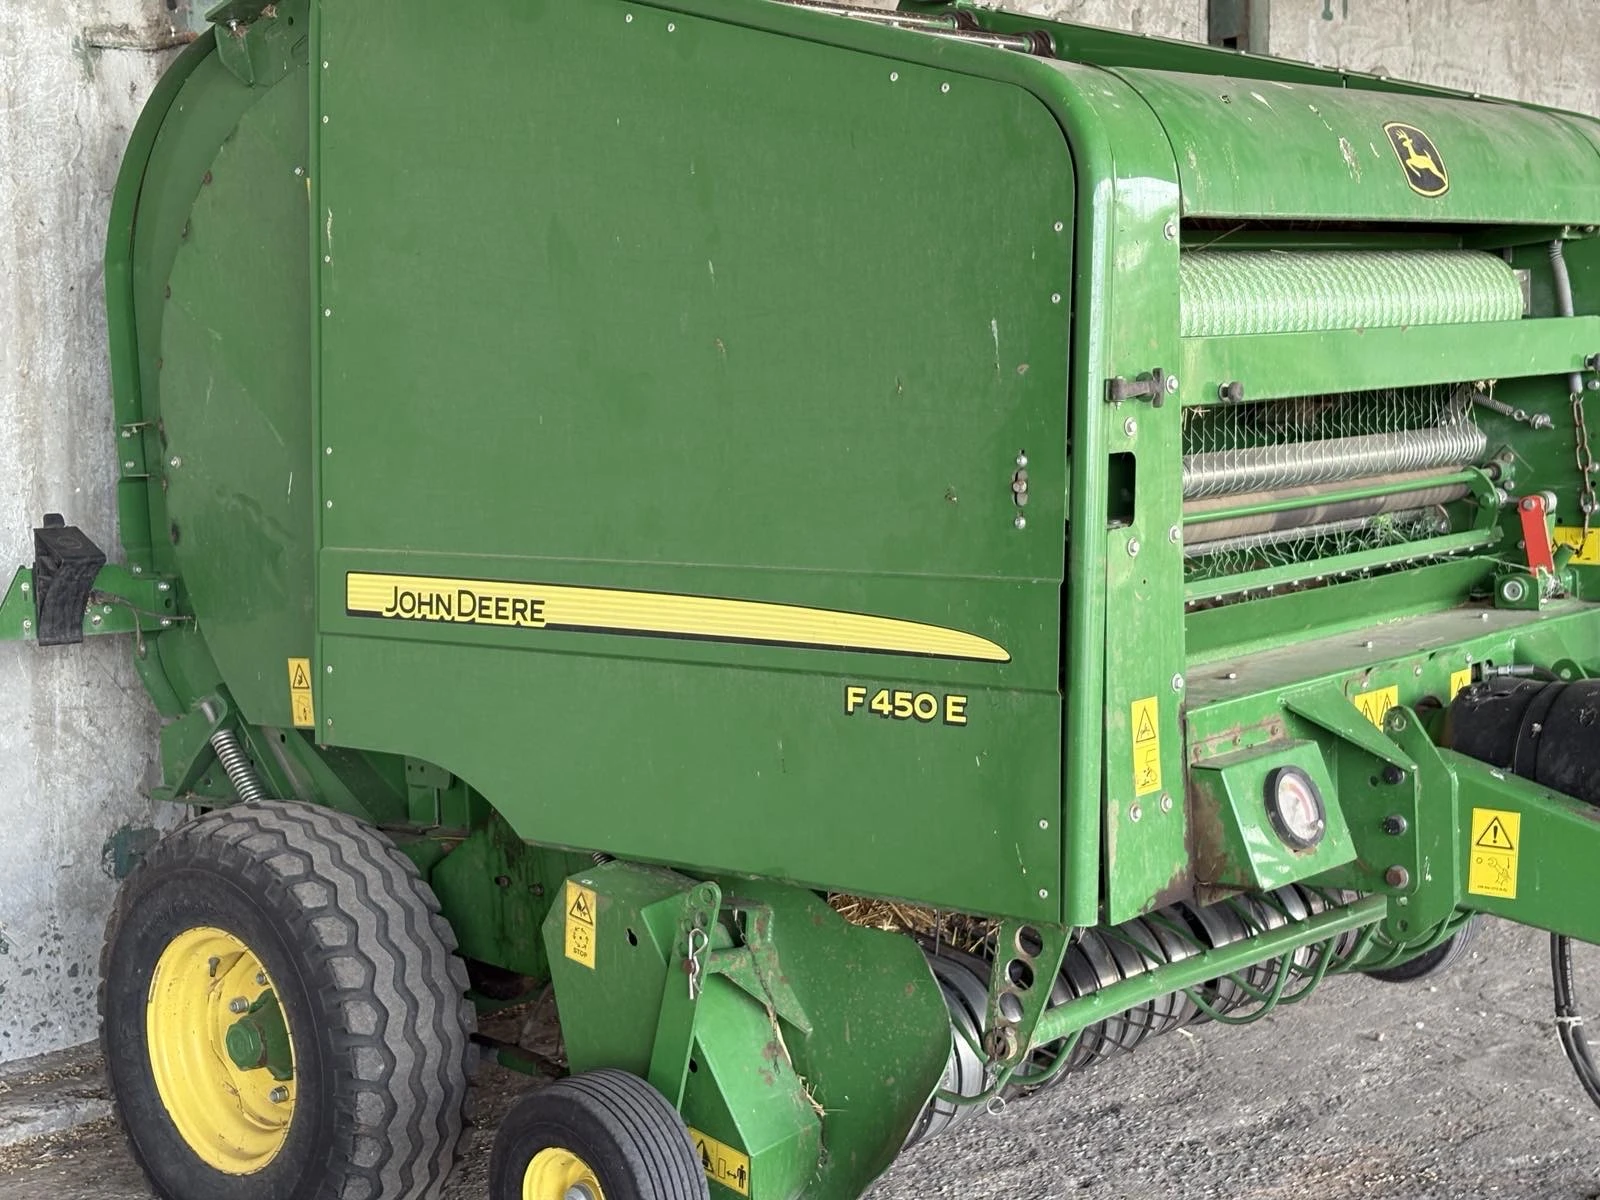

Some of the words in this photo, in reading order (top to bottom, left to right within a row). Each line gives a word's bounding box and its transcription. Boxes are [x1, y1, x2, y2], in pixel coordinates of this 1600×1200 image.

[385, 586, 452, 616] JOHN
[457, 589, 545, 623] DEERE
[846, 685, 867, 714] F
[869, 689, 938, 721] 450
[944, 694, 967, 725] E
[573, 947, 588, 958] STOP
